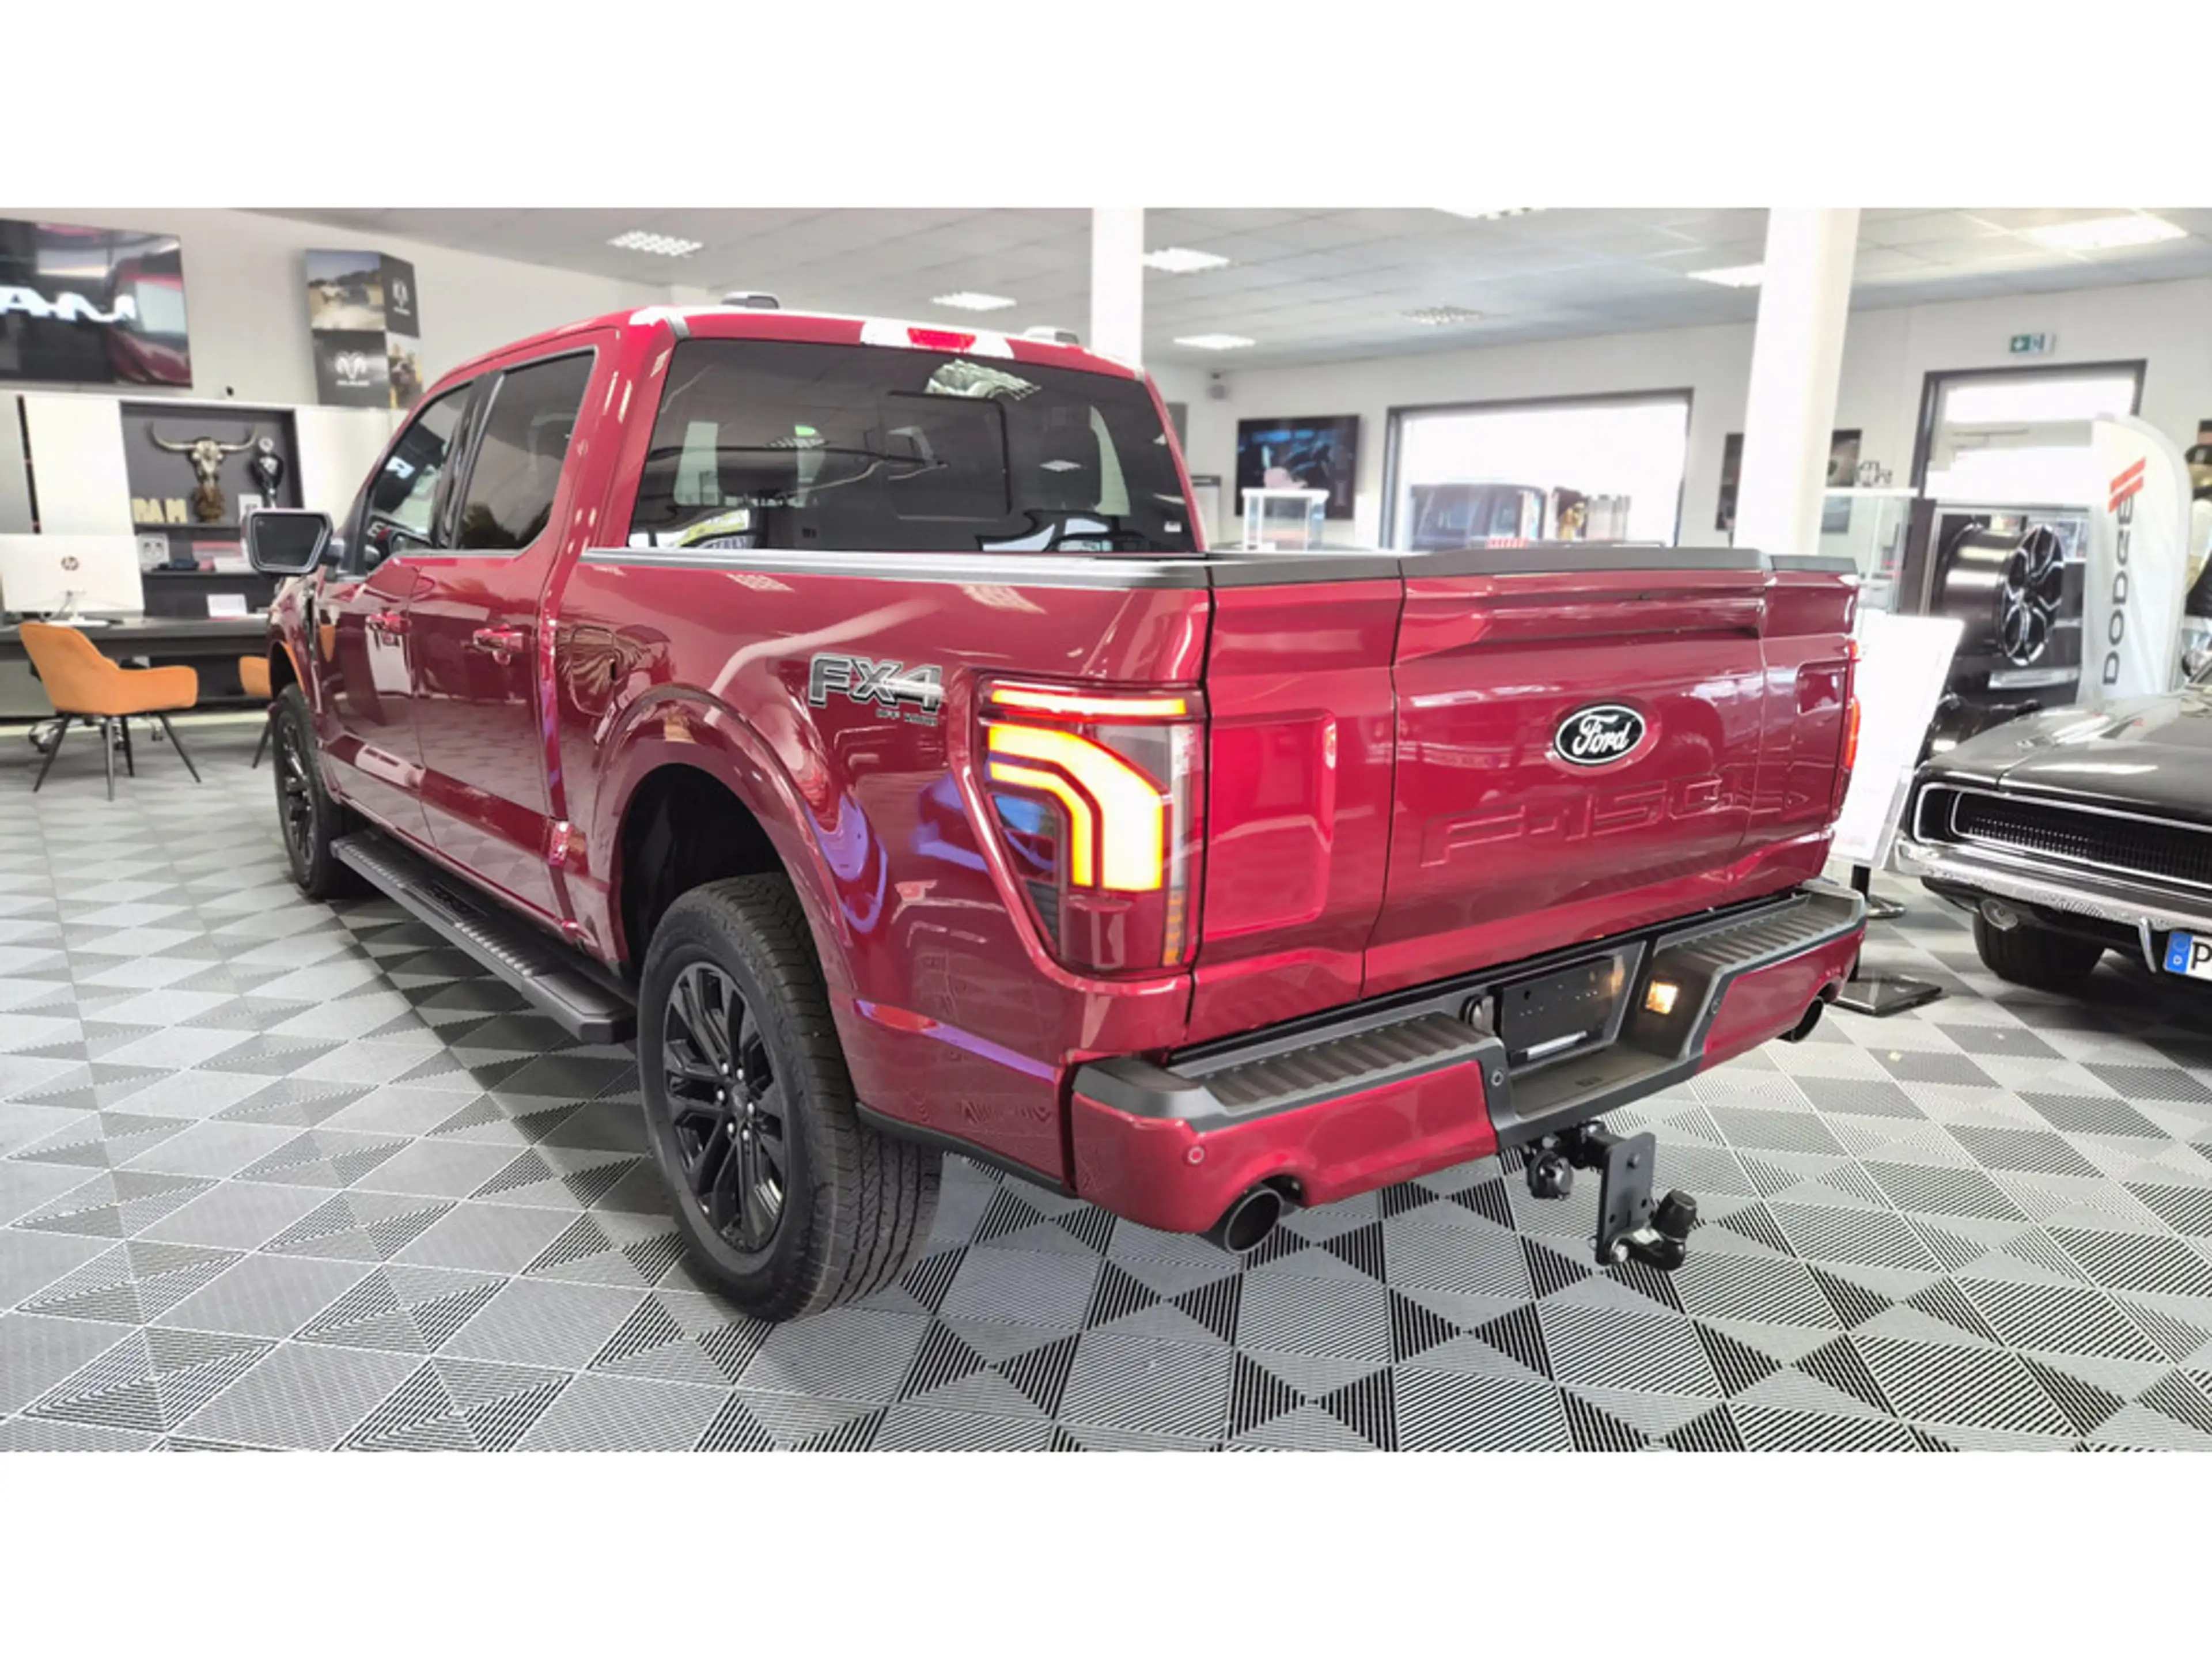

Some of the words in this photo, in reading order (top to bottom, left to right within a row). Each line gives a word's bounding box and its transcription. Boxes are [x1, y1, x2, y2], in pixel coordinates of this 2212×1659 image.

[2103, 493, 2134, 685] DODGE
[809, 652, 944, 715] FX4
[1572, 714, 1631, 755] Ford
